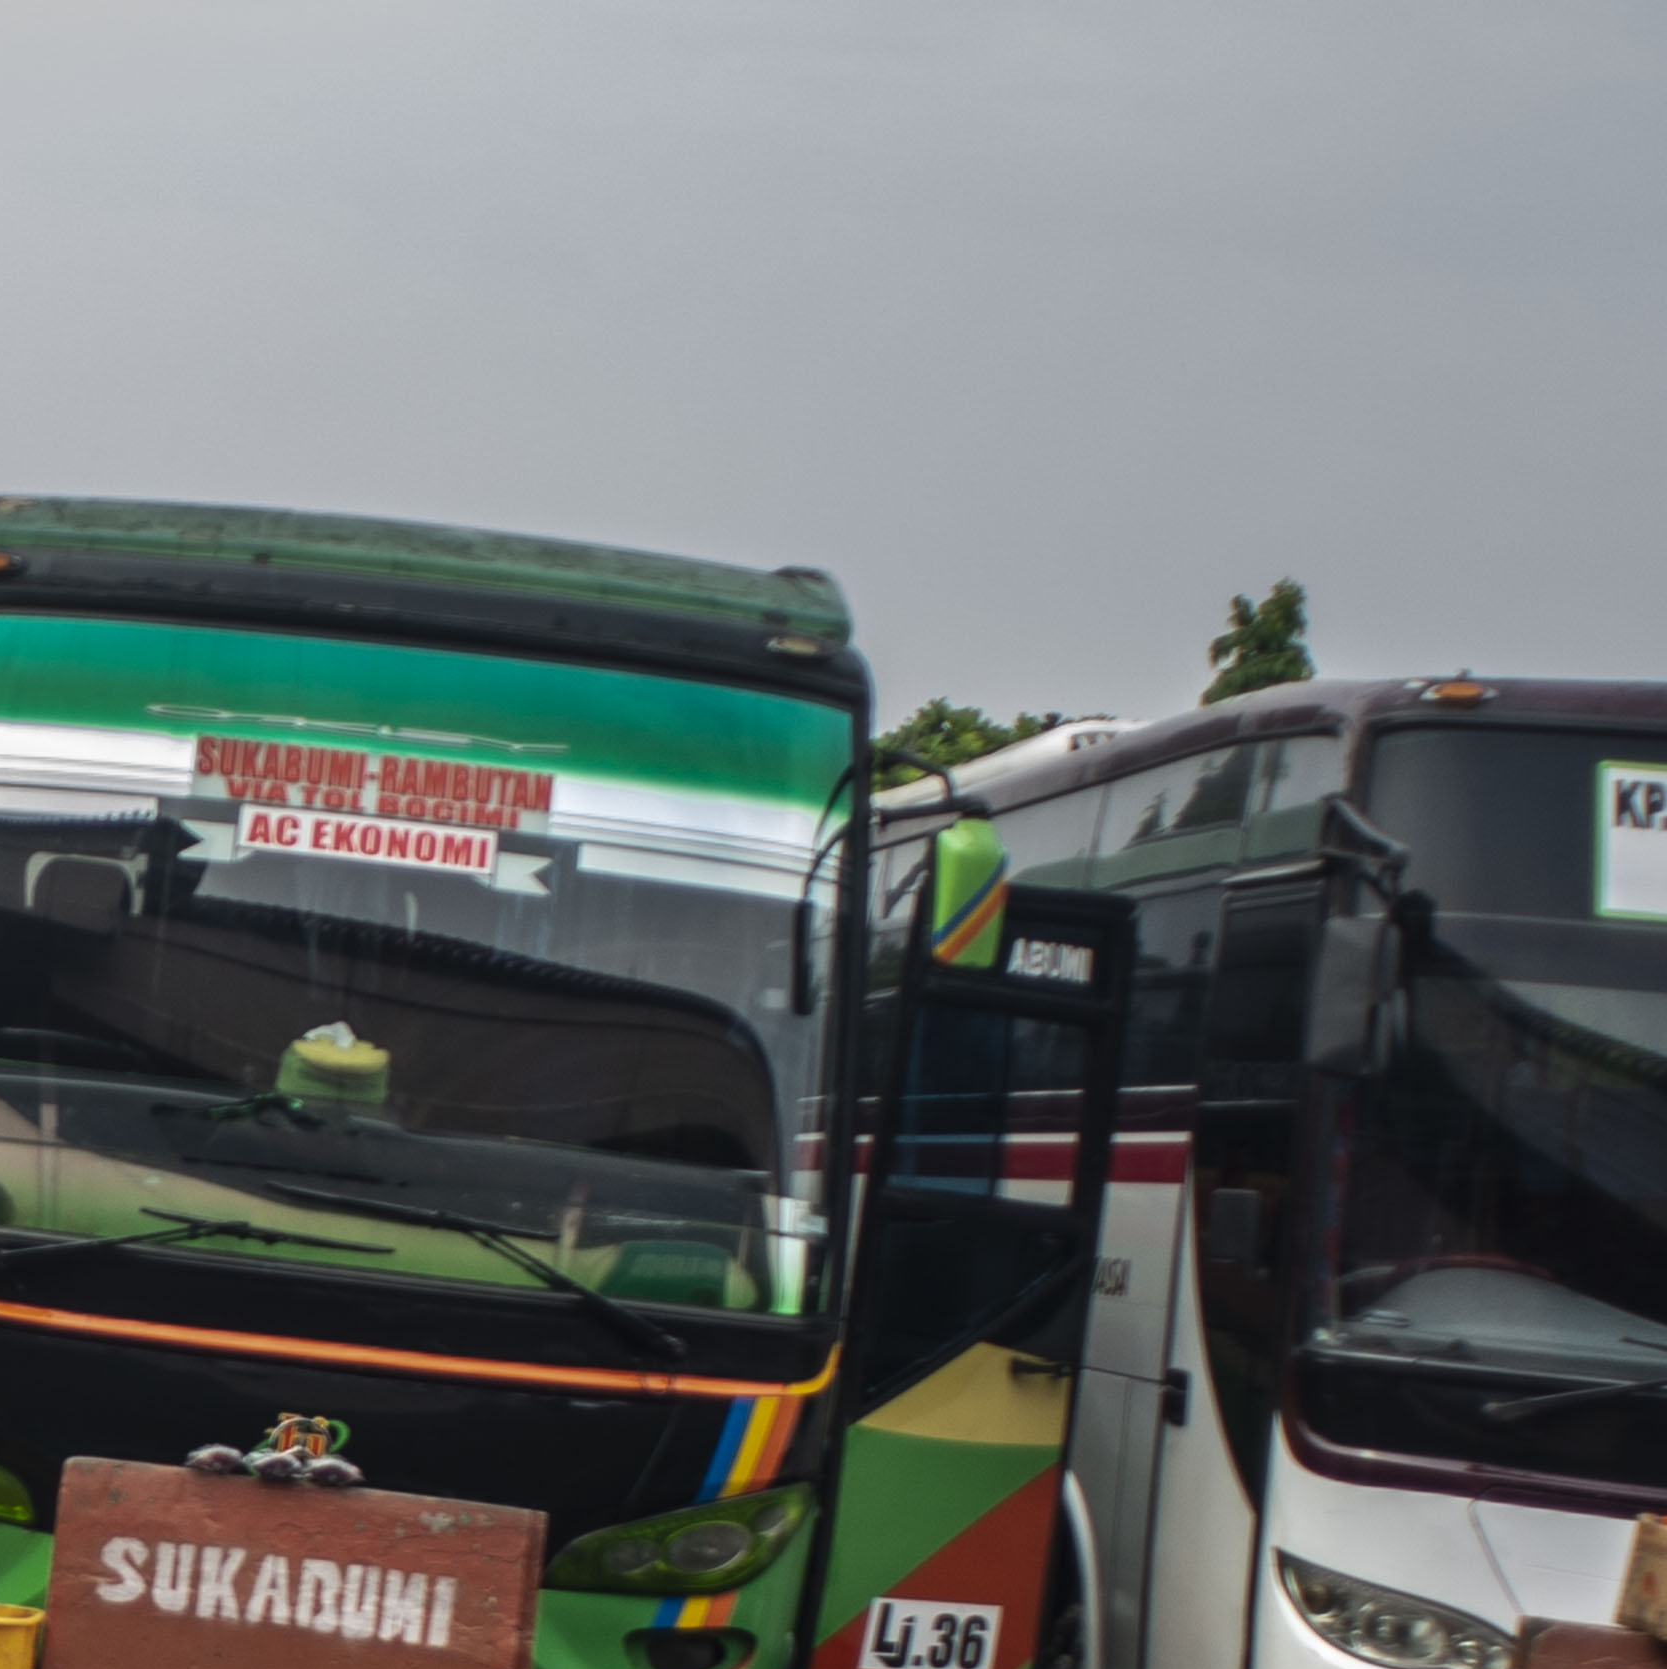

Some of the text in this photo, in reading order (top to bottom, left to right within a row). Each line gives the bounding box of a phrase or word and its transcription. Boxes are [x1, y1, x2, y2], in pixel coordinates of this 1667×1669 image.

[247, 813, 490, 869] AC EKONOMI
[94, 1536, 458, 1648] SUKABUMI
